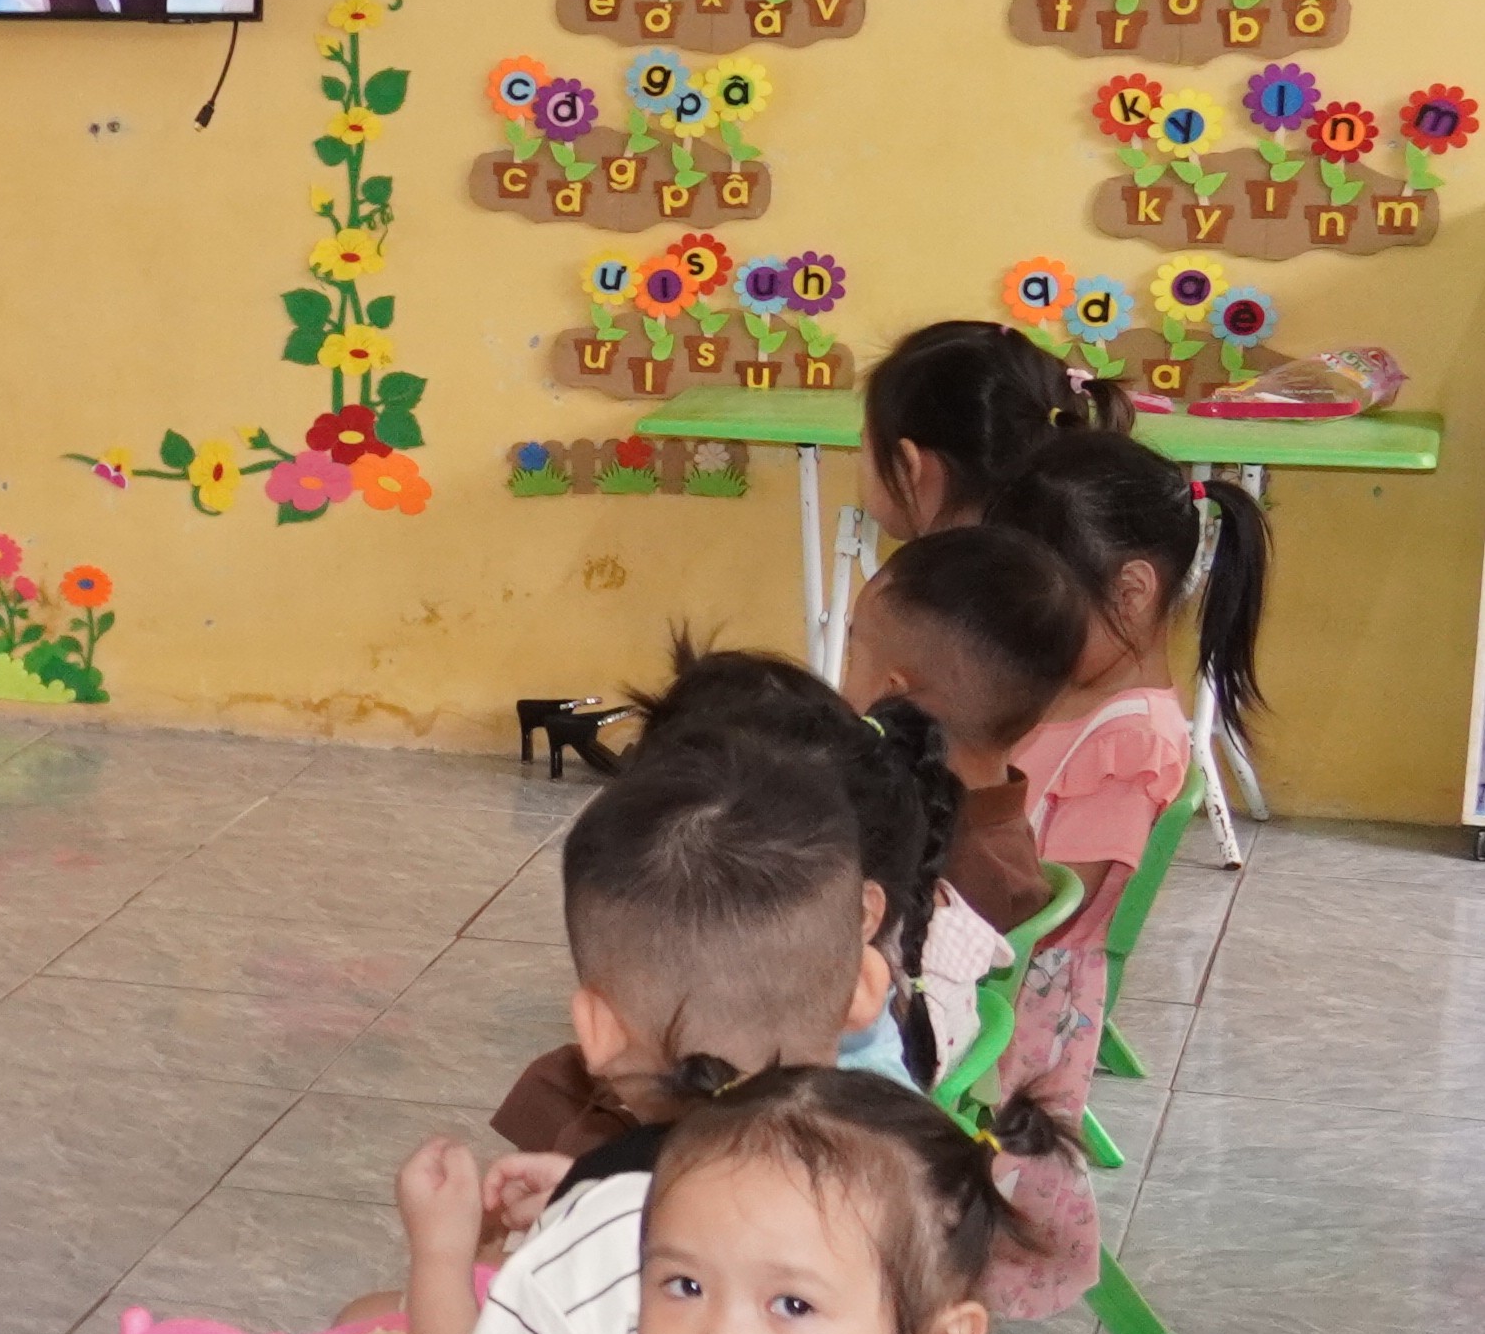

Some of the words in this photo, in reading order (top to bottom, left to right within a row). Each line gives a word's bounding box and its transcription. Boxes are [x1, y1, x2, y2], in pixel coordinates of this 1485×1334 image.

[644, 4, 672, 33] ơ
[753, 2, 782, 36] ă
[1114, 17, 1130, 44] r
[1229, 10, 1259, 43] b
[1295, 0, 1325, 34] ô
[506, 77, 530, 101] c
[553, 92, 579, 122] đ
[642, 65, 673, 97] g
[676, 92, 701, 122] p
[723, 75, 750, 106] â
[1118, 91, 1146, 122] k
[1167, 110, 1194, 144] y
[1328, 116, 1355, 142] n
[1414, 104, 1460, 138] m
[503, 166, 528, 192] c
[555, 182, 583, 213] đ
[609, 158, 637, 191] g
[662, 184, 689, 215] p
[722, 174, 750, 206] â
[1137, 190, 1161, 222] k
[1195, 208, 1221, 240] y
[1318, 211, 1345, 237] n
[1377, 200, 1420, 227] m
[687, 253, 704, 276] s
[753, 274, 776, 296] u
[803, 266, 824, 295] h
[1023, 276, 1050, 307] q
[1083, 292, 1110, 323] d
[1177, 275, 1205, 301] a
[584, 343, 611, 369] ư
[697, 343, 715, 366] s
[746, 367, 770, 390] u
[1152, 365, 1180, 390] a
